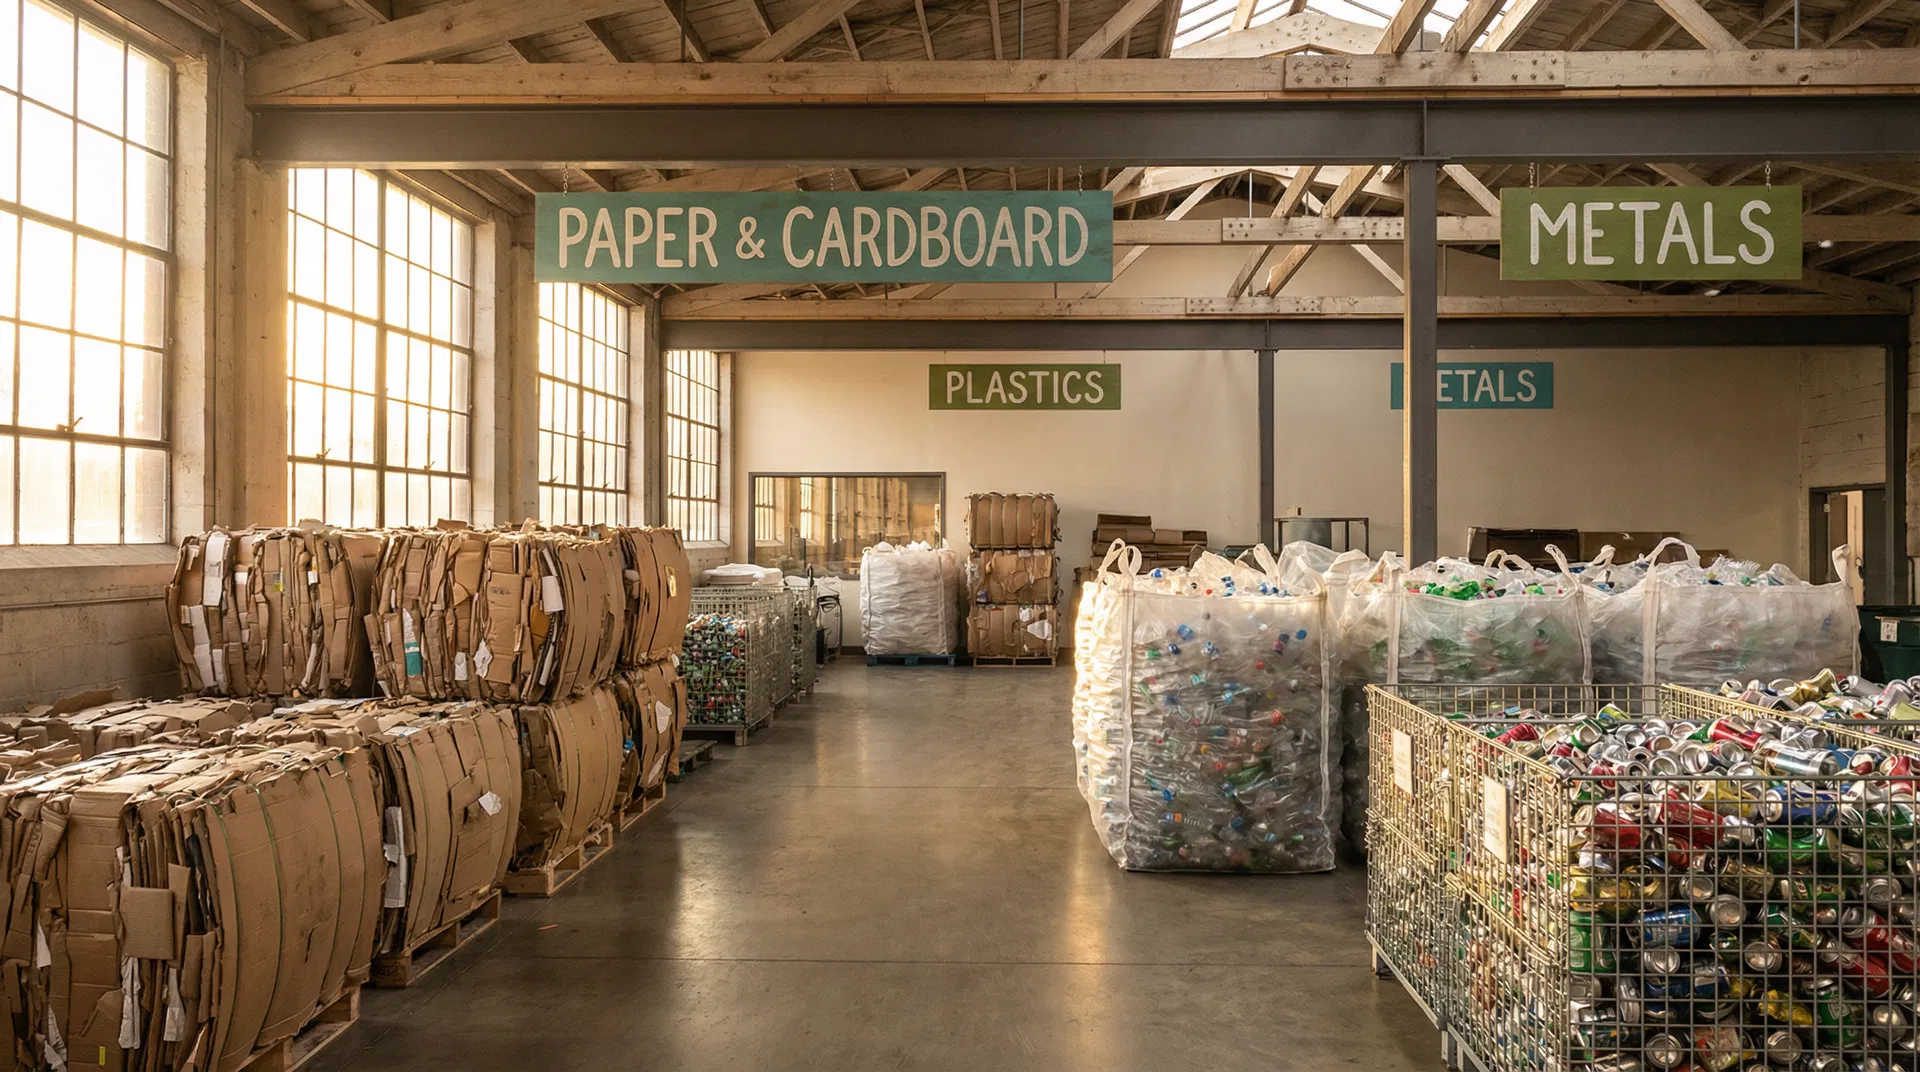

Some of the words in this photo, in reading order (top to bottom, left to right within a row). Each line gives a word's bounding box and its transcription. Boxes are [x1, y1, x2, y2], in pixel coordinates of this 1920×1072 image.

[558, 206, 719, 269] PAPER
[735, 216, 766, 260] &
[782, 205, 1089, 268] CARDBOARD
[1529, 199, 1775, 265] METALS
[946, 370, 1104, 405] PLASTICS
[1437, 369, 1537, 403] ETALS
